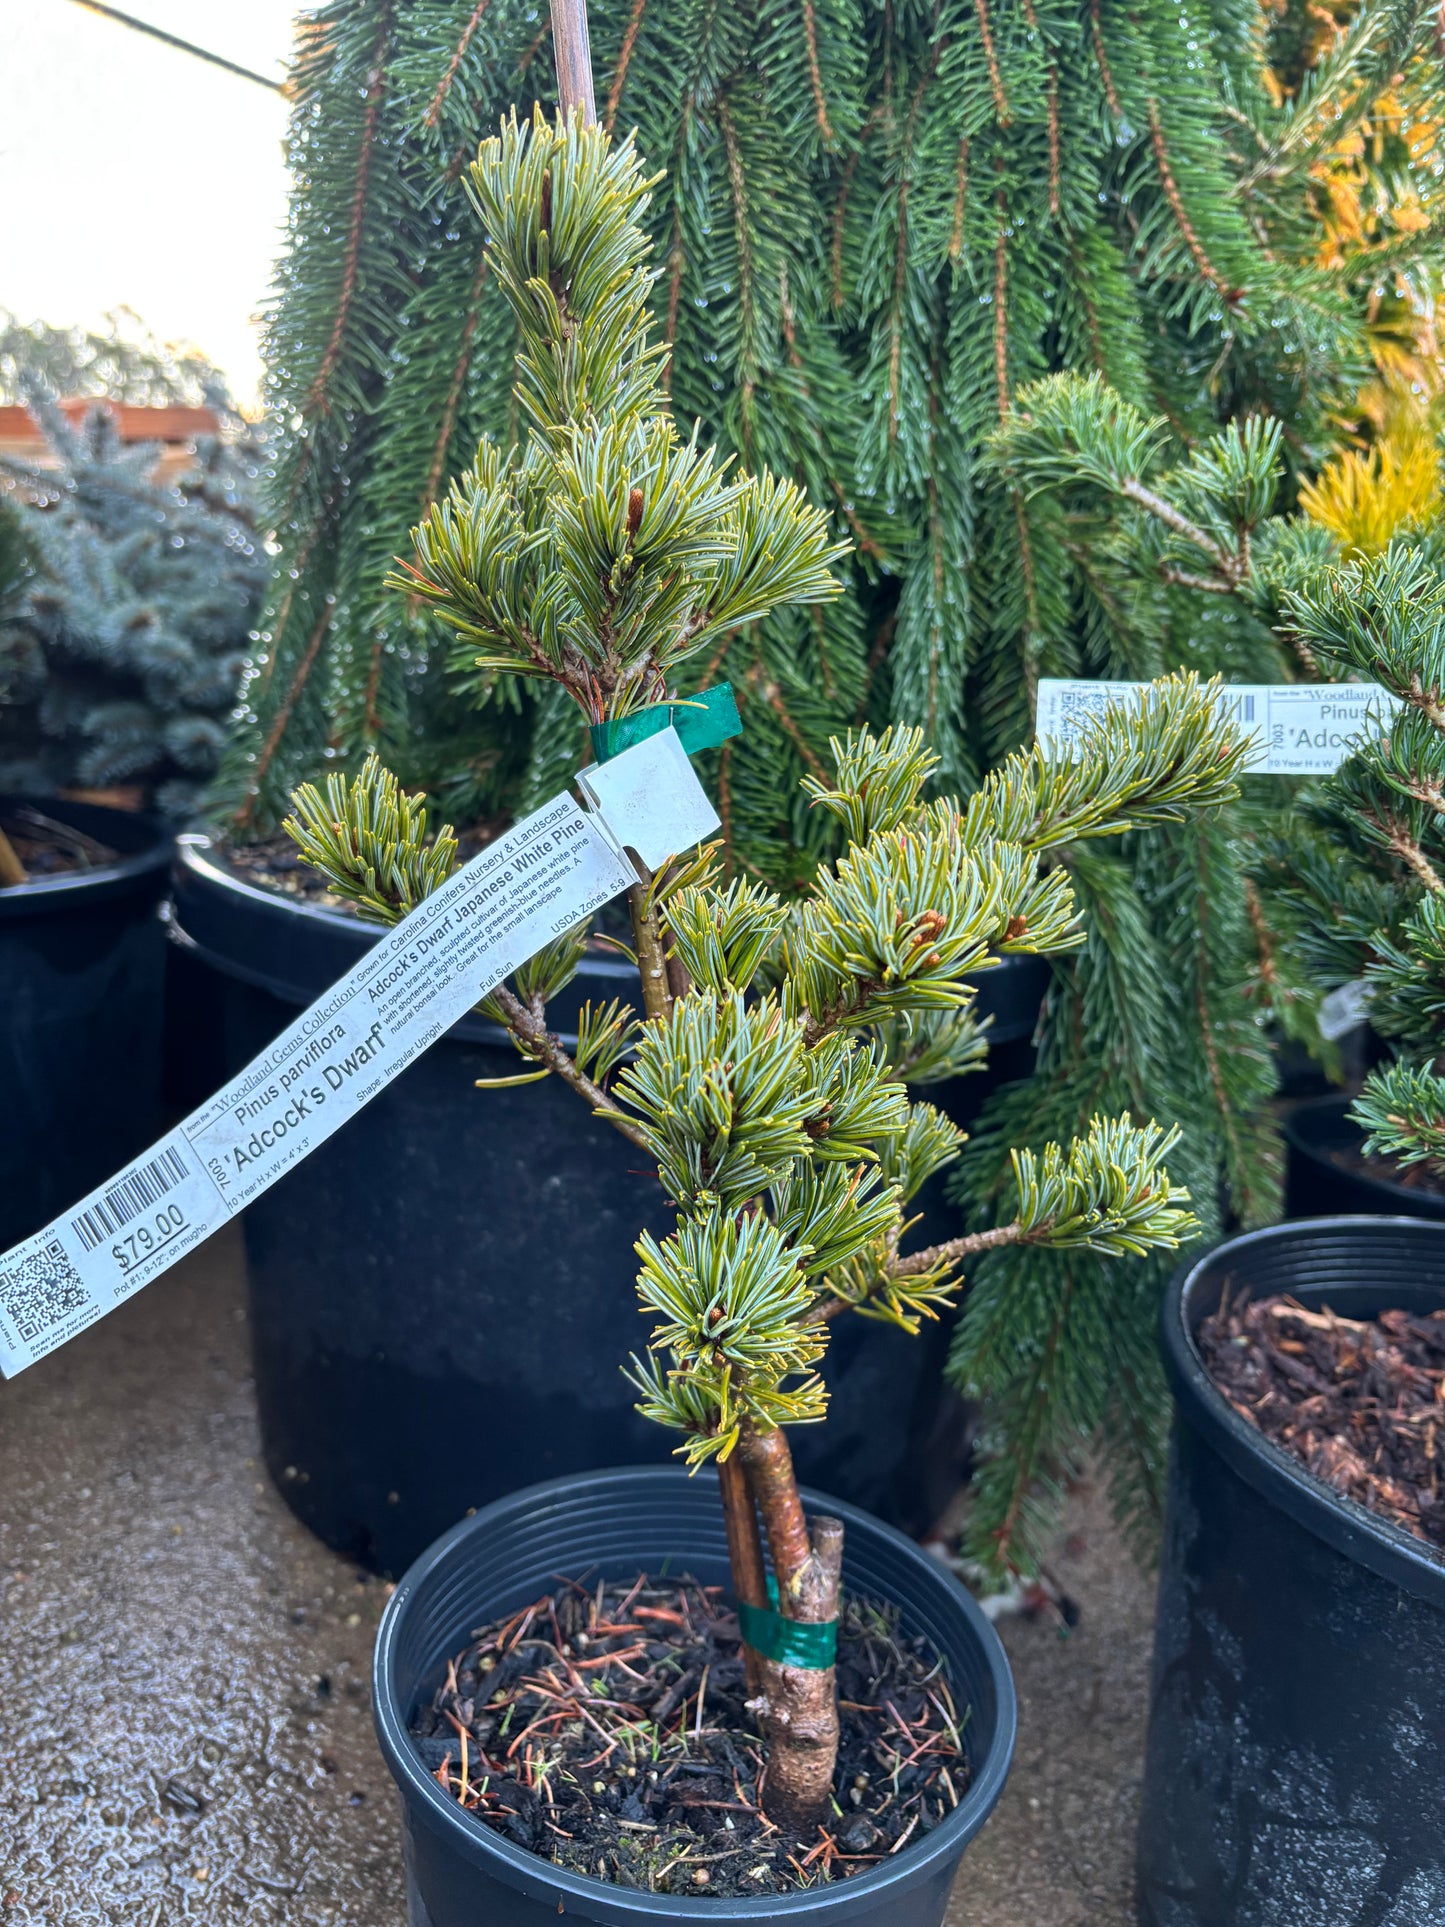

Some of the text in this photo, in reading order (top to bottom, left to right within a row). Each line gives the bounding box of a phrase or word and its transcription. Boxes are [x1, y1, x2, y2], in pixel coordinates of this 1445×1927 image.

[368, 820, 584, 1003] Adcock's Dwarf Japanese White Pine
[377, 838, 589, 1016] An open branched, sculpted cultivar of Japanese white pine
[383, 857, 582, 1024] with shortened, slightly twisted greenish-blue needles. A
[550, 878, 626, 933] USDA Zones 5-9
[211, 1060, 273, 1111] "Woodland
[272, 1034, 305, 1064] Gems
[302, 979, 356, 1035] Collection"
[357, 960, 379, 982] Grown
[378, 949, 389, 961] for
[390, 916, 427, 951] Carolina
[426, 883, 466, 917] Conifers
[464, 851, 504, 884] Nursery
[504, 843, 514, 853] &
[513, 804, 570, 846] Landscape
[390, 886, 562, 1035] nutural bonsai look. Great for the small lanscape
[479, 962, 514, 992] Full Sun
[224, 1021, 385, 1172] 'Adcock's Dwarf'
[234, 1025, 346, 1126] Pinus parviflora
[356, 1022, 443, 1102] Shape: Irregular Upright
[208, 1158, 231, 1190] 7003
[226, 1197, 238, 1209] 10
[237, 1182, 257, 1200] Year
[256, 1175, 266, 1185] H
[270, 1161, 281, 1173] W
[289, 1149, 295, 1159] 4'
[302, 1137, 309, 1147] 3'
[34, 1228, 56, 1245] Info
[112, 1204, 183, 1269] $79.00
[113, 1282, 130, 1297] Pot
[130, 1272, 145, 1285] #1;
[169, 1245, 180, 1256] on
[180, 1224, 207, 1247] mugho
